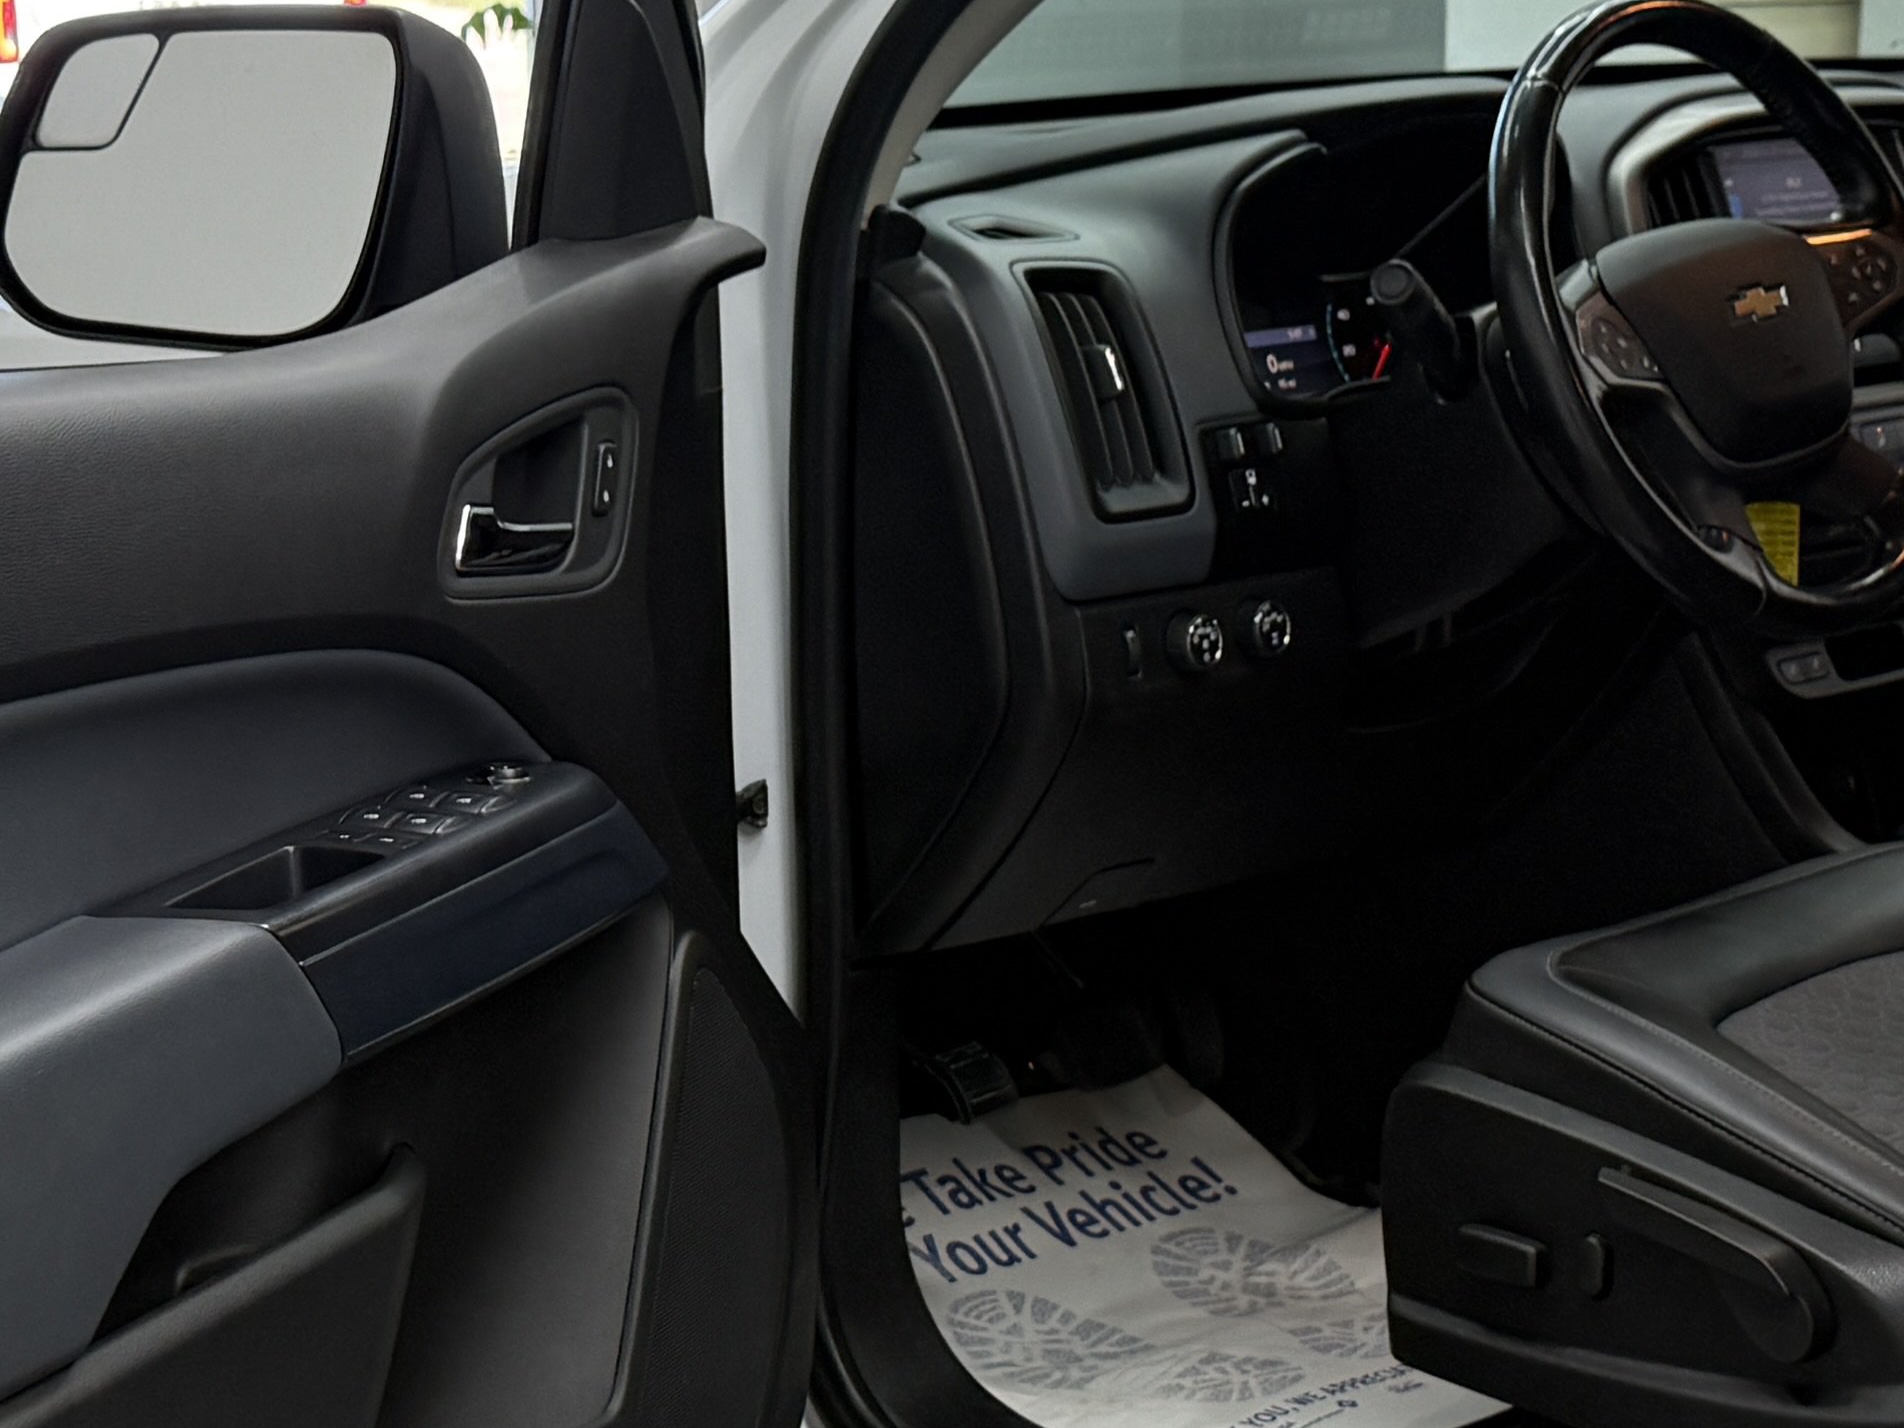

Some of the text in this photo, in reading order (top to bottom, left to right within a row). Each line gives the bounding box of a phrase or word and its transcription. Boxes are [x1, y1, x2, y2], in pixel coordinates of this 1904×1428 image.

[901, 1126, 1169, 1216] Take Pride
[908, 1155, 1239, 1284] Your Vehicle!
